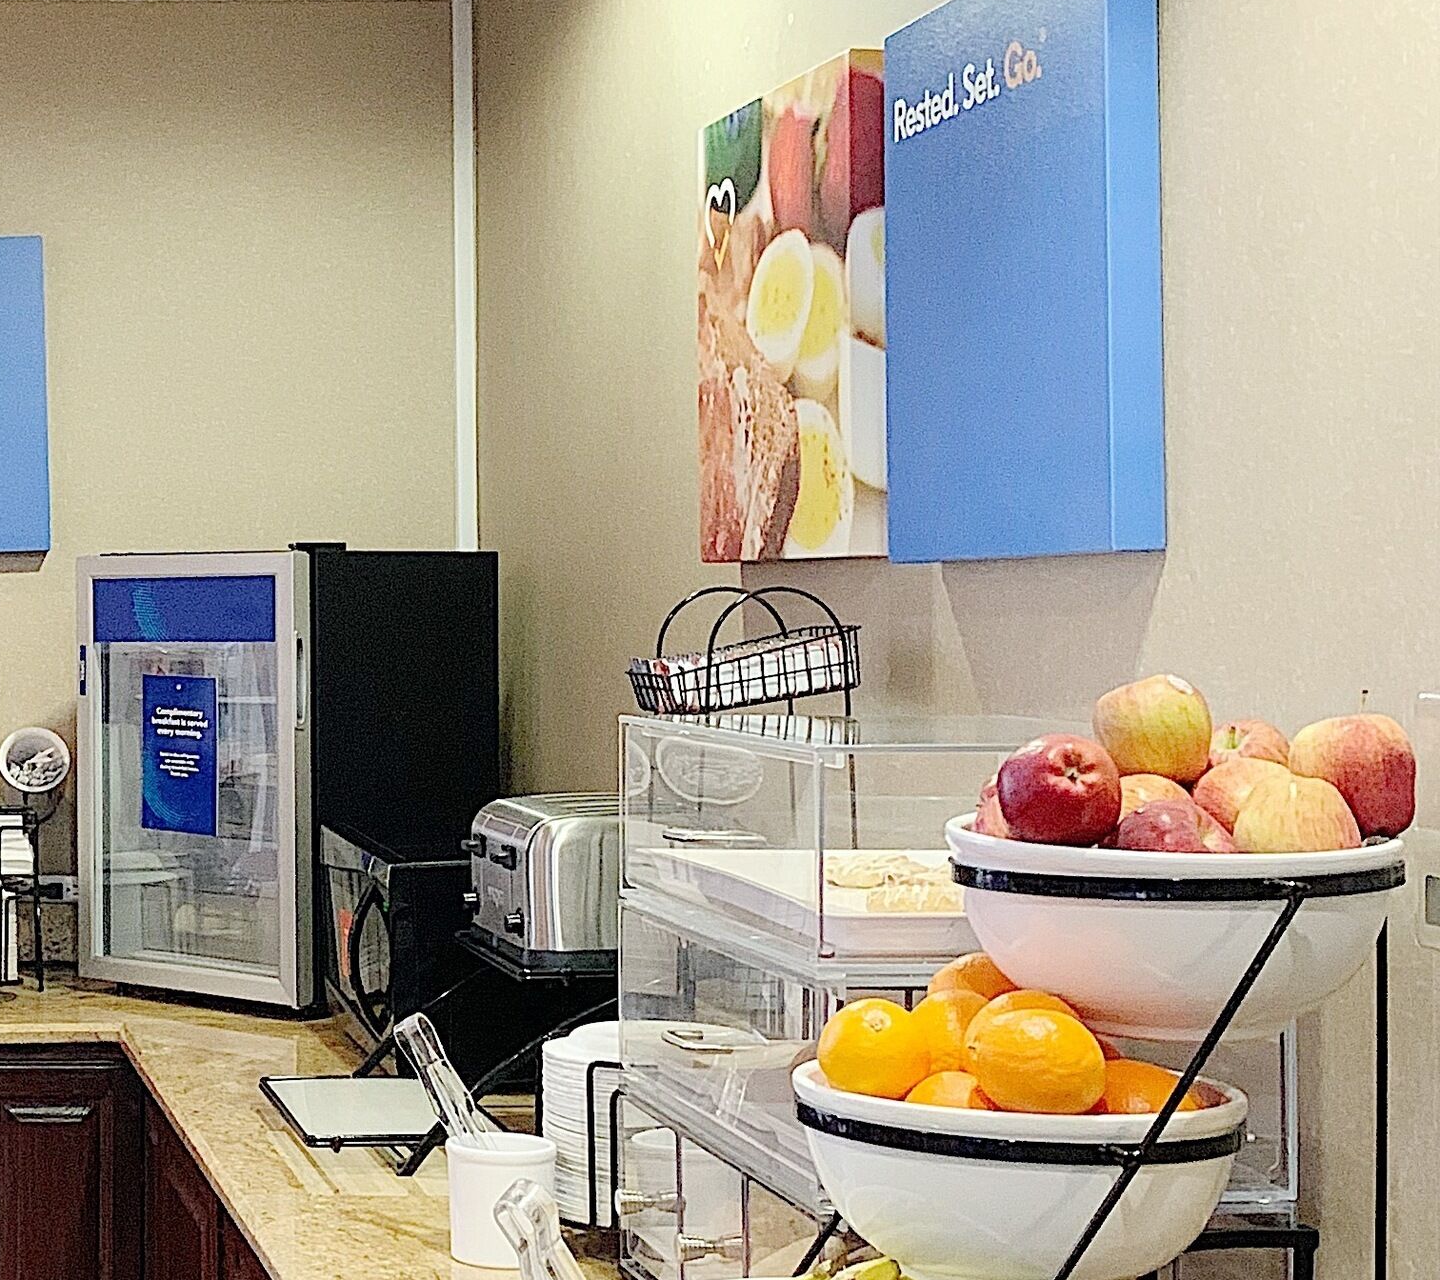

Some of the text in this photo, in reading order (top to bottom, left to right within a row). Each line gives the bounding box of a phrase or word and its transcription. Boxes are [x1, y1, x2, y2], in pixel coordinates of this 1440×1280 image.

[893, 41, 1042, 143] Rested. Set. Go.
